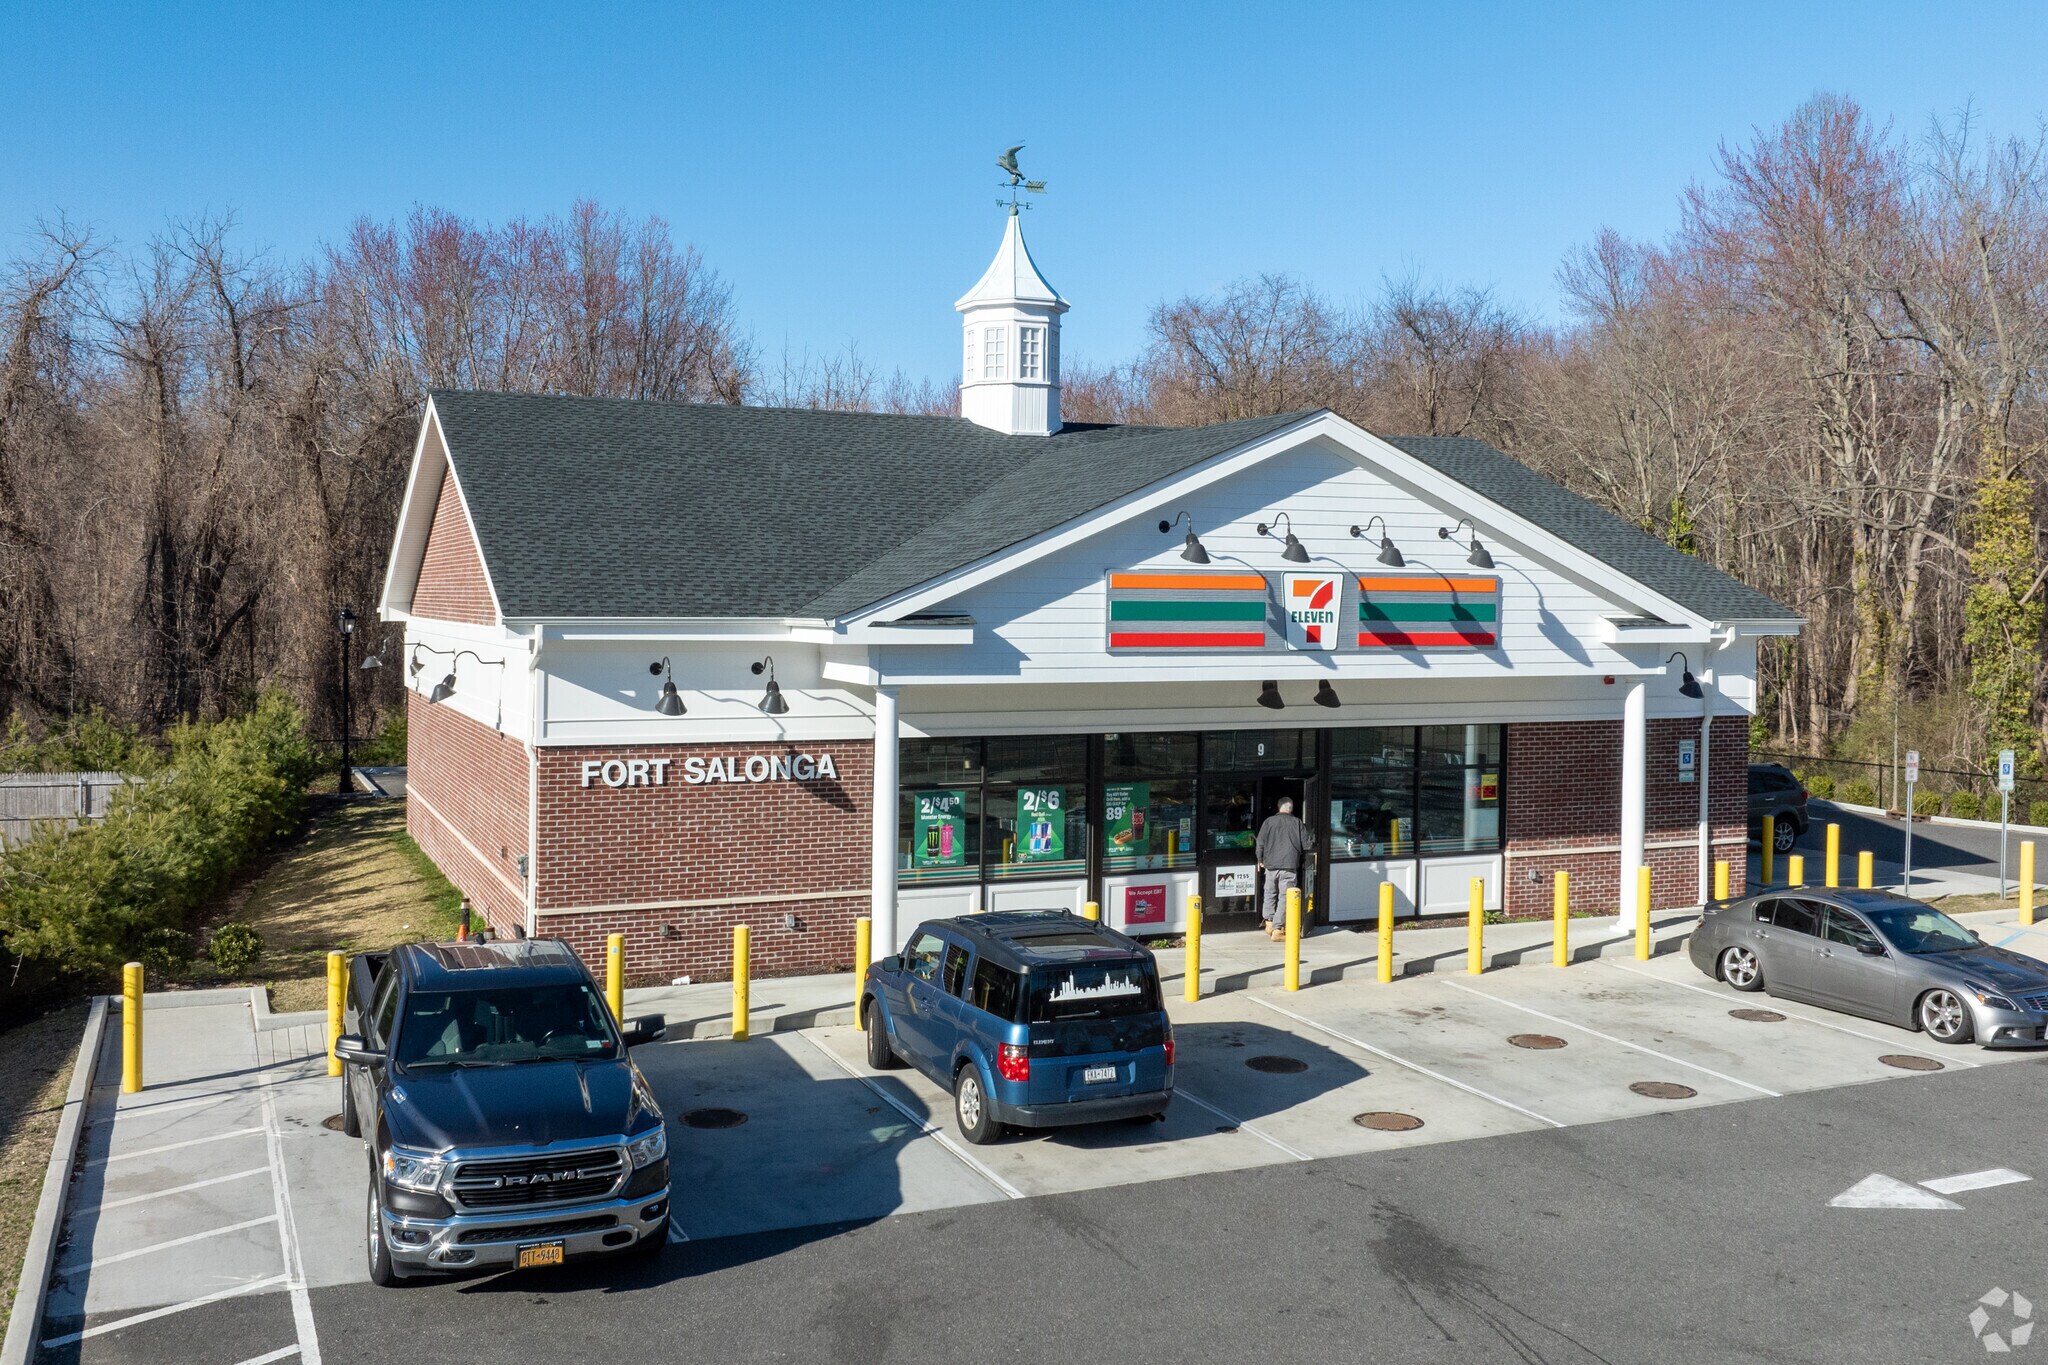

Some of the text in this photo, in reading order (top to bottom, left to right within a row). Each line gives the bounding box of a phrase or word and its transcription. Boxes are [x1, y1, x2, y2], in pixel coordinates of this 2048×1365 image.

[1293, 580, 1333, 643] 7
[1257, 743, 1265, 756] 9
[582, 754, 837, 788] FORT SALONGA
[505, 1171, 576, 1186] RAM
